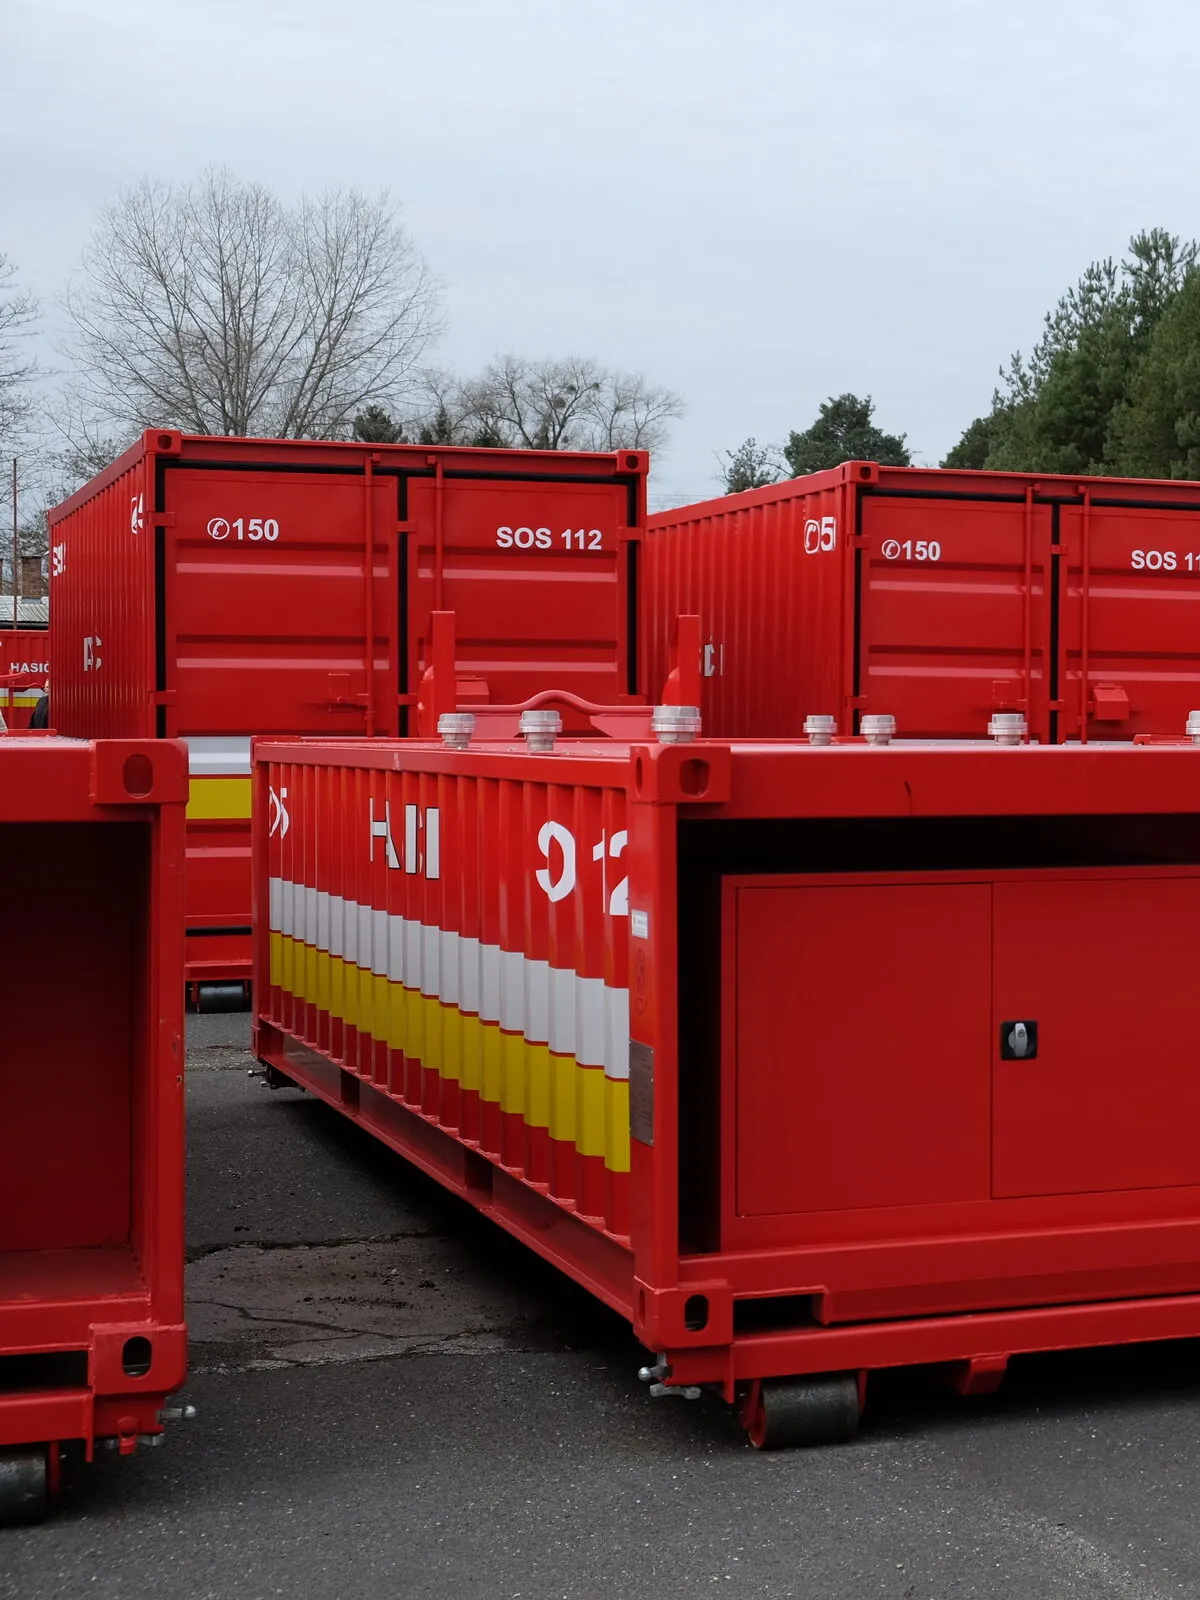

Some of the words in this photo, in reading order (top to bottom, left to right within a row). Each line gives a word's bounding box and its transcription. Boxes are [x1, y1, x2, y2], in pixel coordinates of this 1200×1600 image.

[232, 518, 279, 541] 150
[496, 526, 552, 549] SOS
[561, 528, 602, 550] 112
[902, 540, 941, 561] 150
[1131, 549, 1177, 571] SOS
